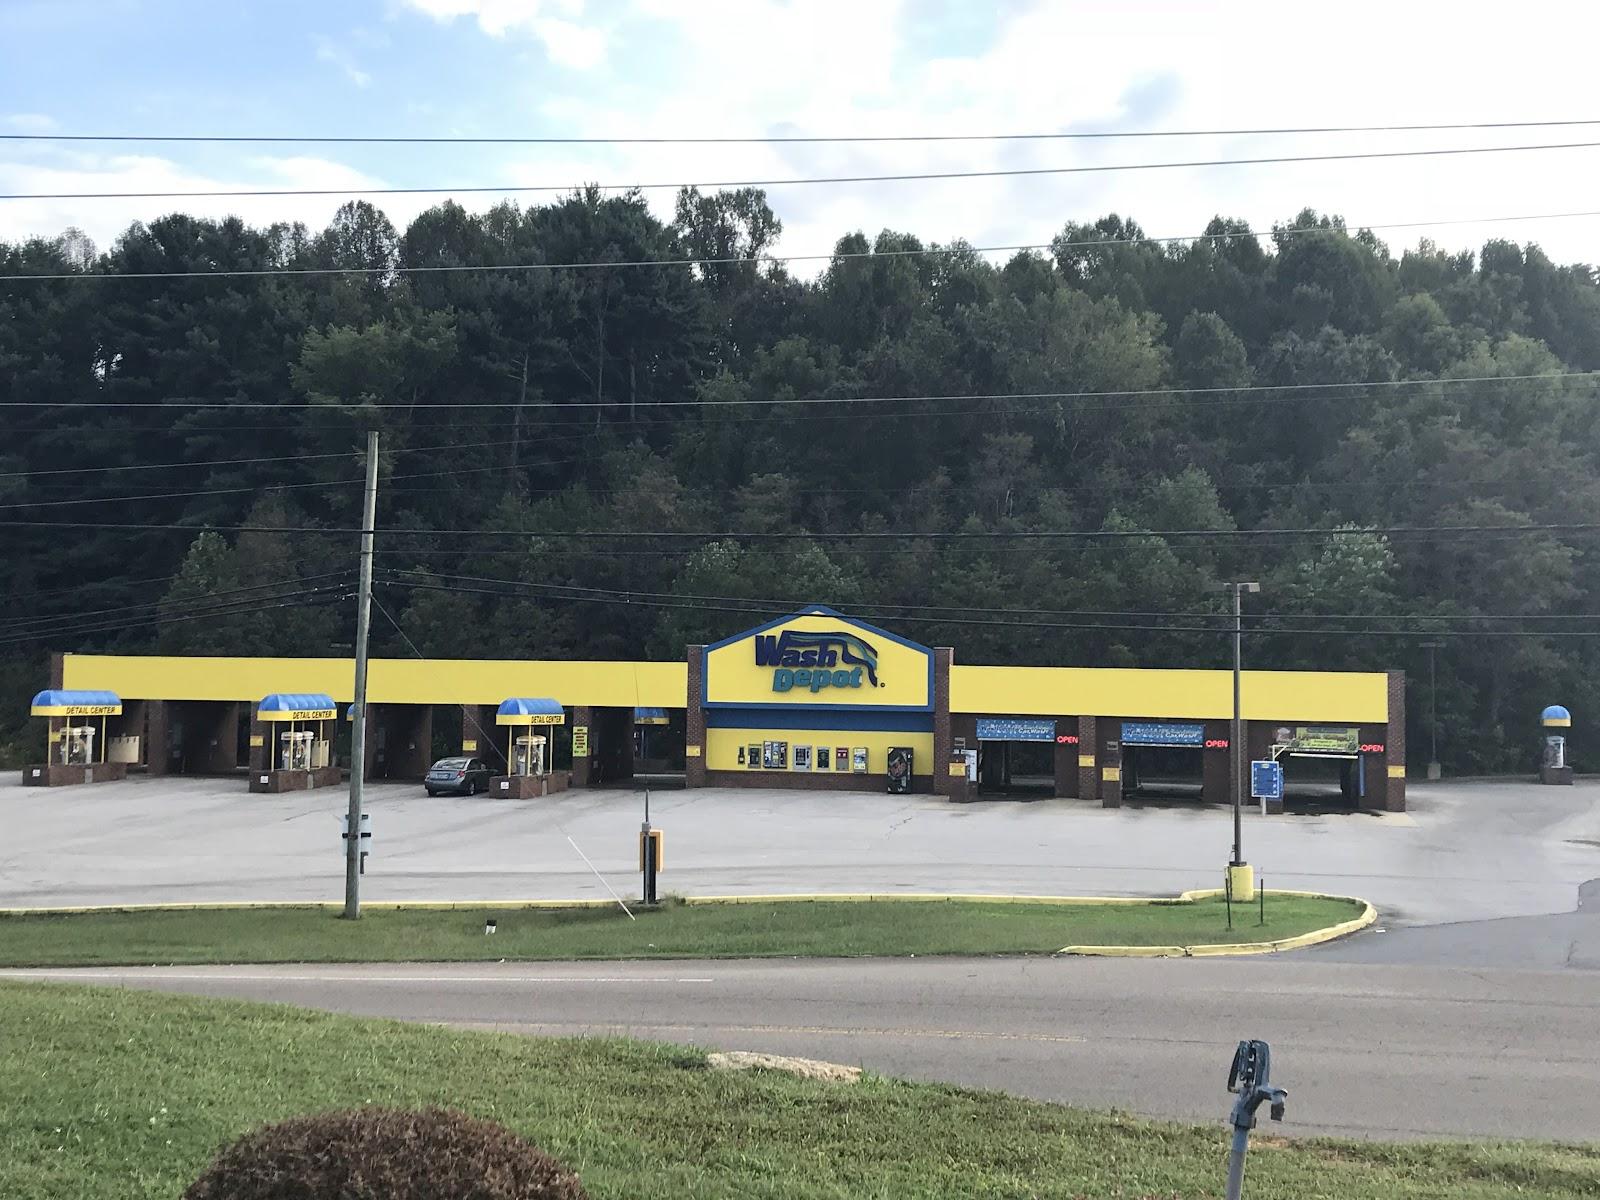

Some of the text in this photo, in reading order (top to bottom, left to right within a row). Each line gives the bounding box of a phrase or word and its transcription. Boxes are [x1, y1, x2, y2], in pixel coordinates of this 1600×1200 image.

[755, 630, 837, 667] Wash
[772, 667, 863, 693] Depot
[66, 706, 115, 715] DETAIL CENTER
[293, 710, 332, 719] DETAIL CENTER
[531, 715, 561, 724] DETAIL CENTER
[1056, 735, 1079, 744] OPEN
[1205, 740, 1229, 748] OPEN
[1360, 744, 1384, 752] OPEN
